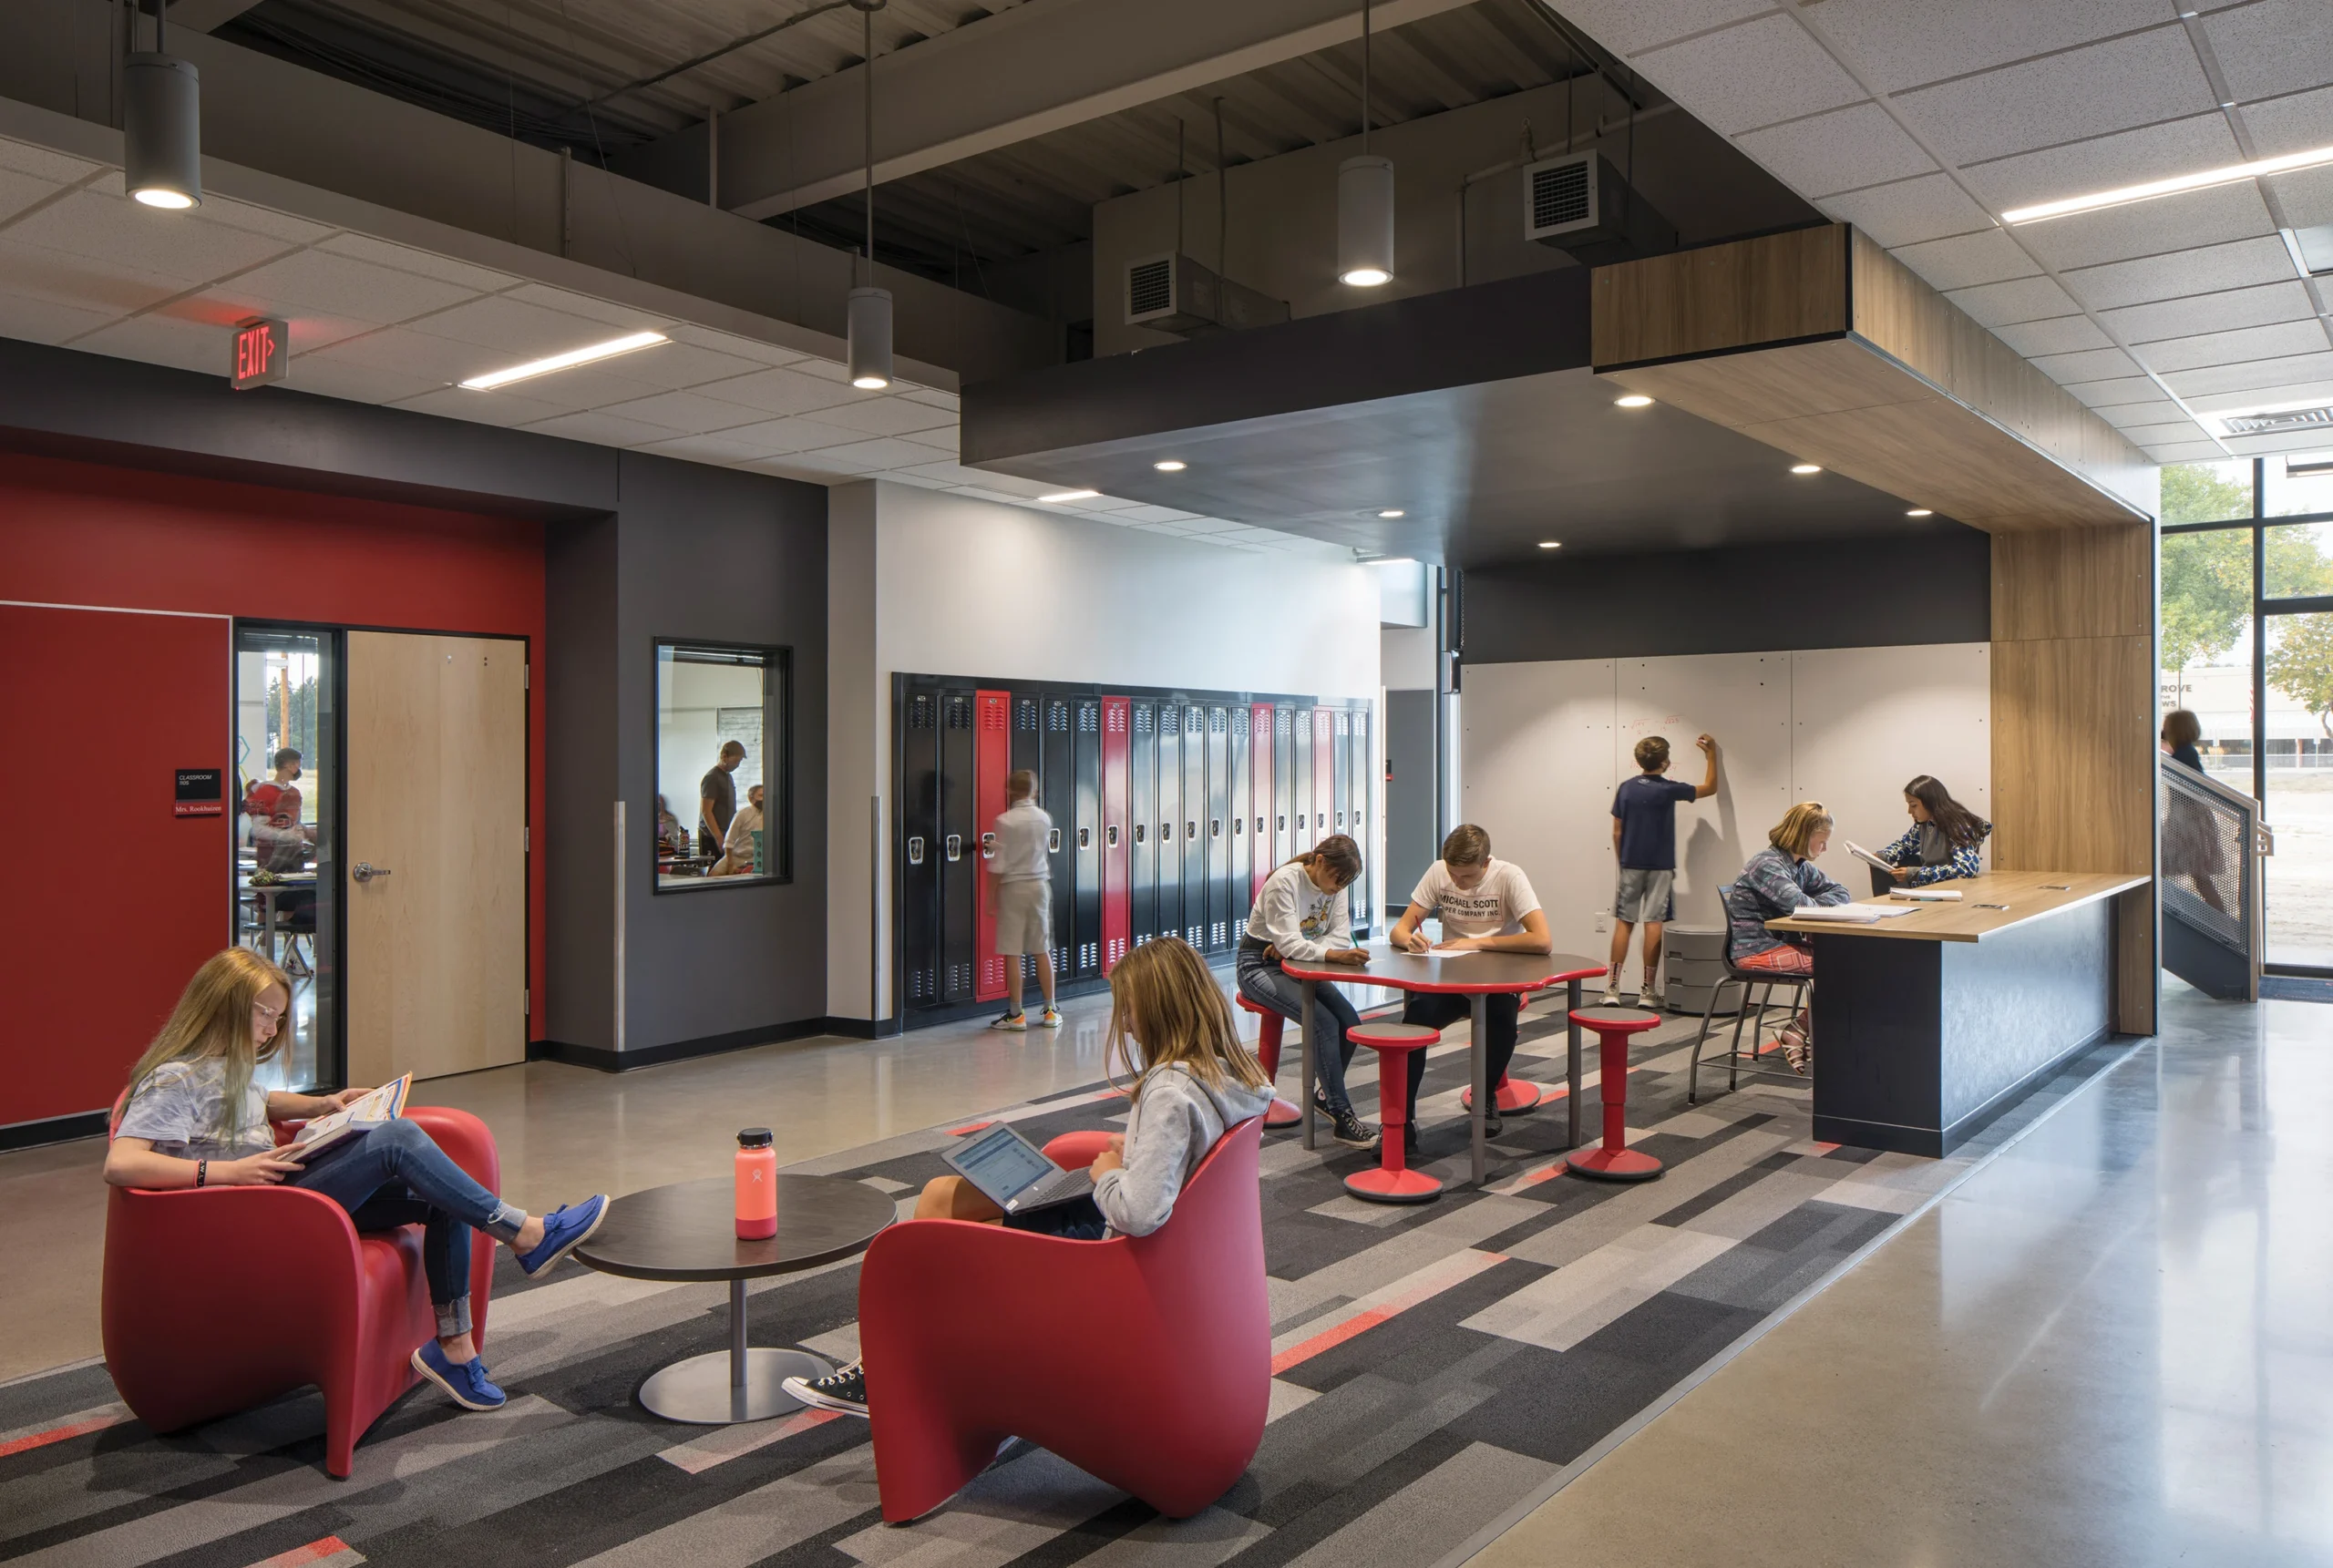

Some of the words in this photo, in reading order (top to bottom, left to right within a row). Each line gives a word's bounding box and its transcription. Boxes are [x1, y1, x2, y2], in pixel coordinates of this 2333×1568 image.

[238, 325, 271, 380] EXIT
[1439, 894, 1471, 908] MICHAEL
[1473, 899, 1498, 908] SCOTT
[1457, 908, 1487, 917] COMPANY
